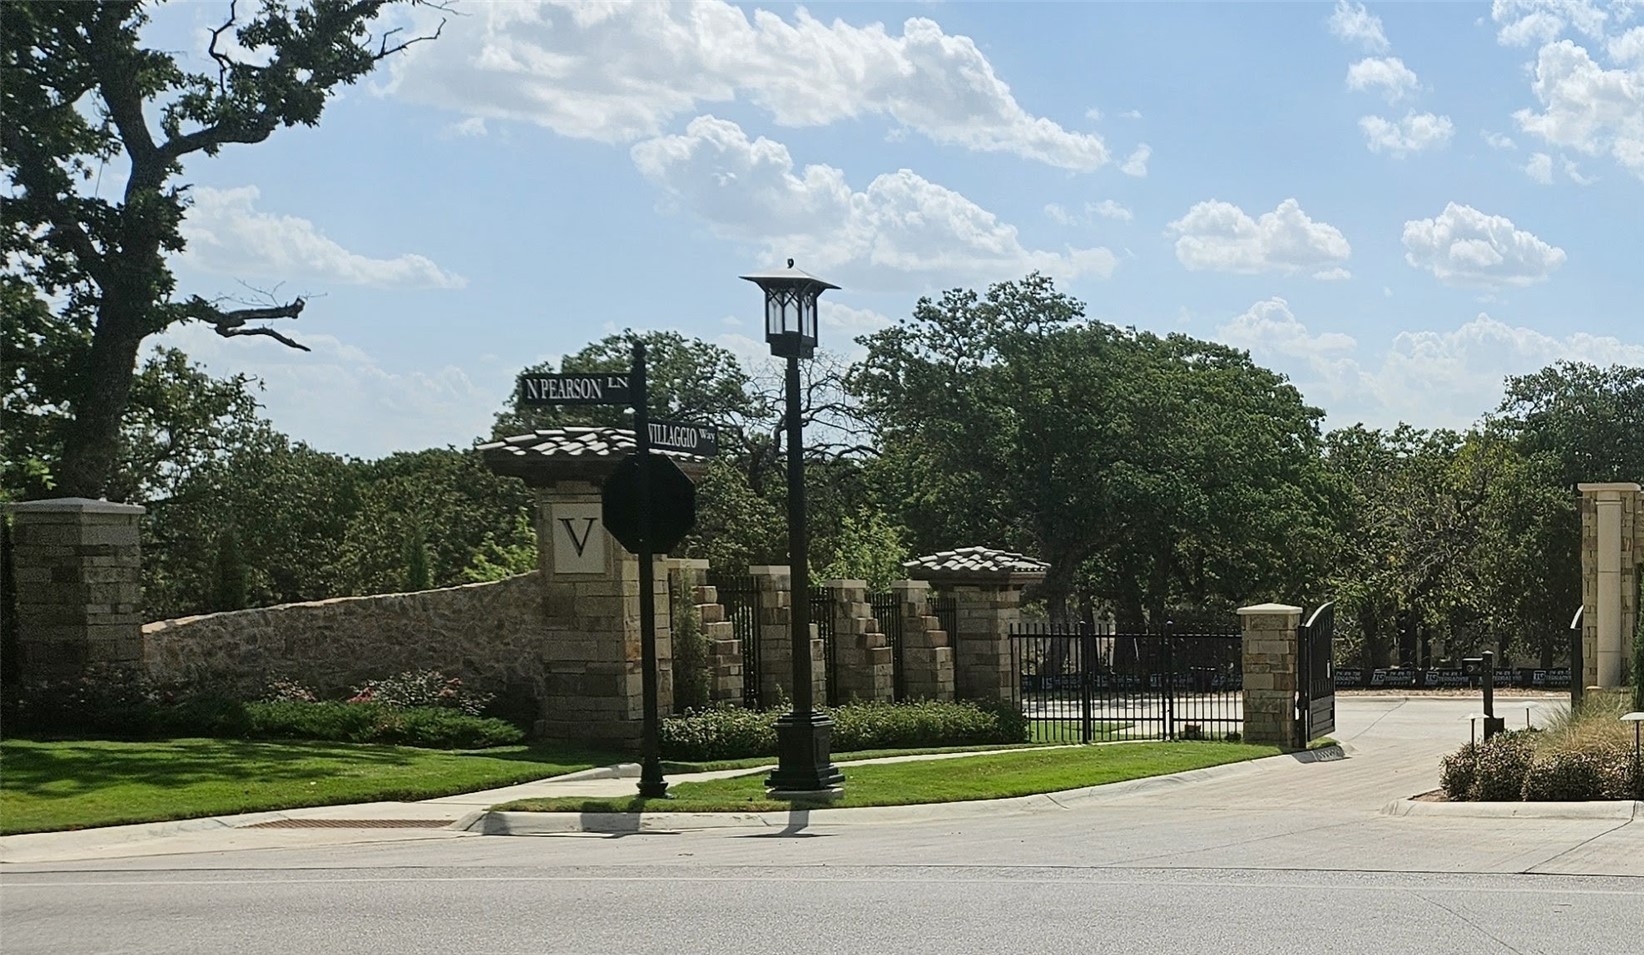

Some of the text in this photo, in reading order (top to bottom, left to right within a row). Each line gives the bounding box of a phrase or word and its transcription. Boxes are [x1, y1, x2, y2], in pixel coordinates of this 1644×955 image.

[526, 377, 629, 399] N PEARSON LN
[648, 423, 715, 449] VILLAGGIO Way
[557, 517, 598, 558] V
